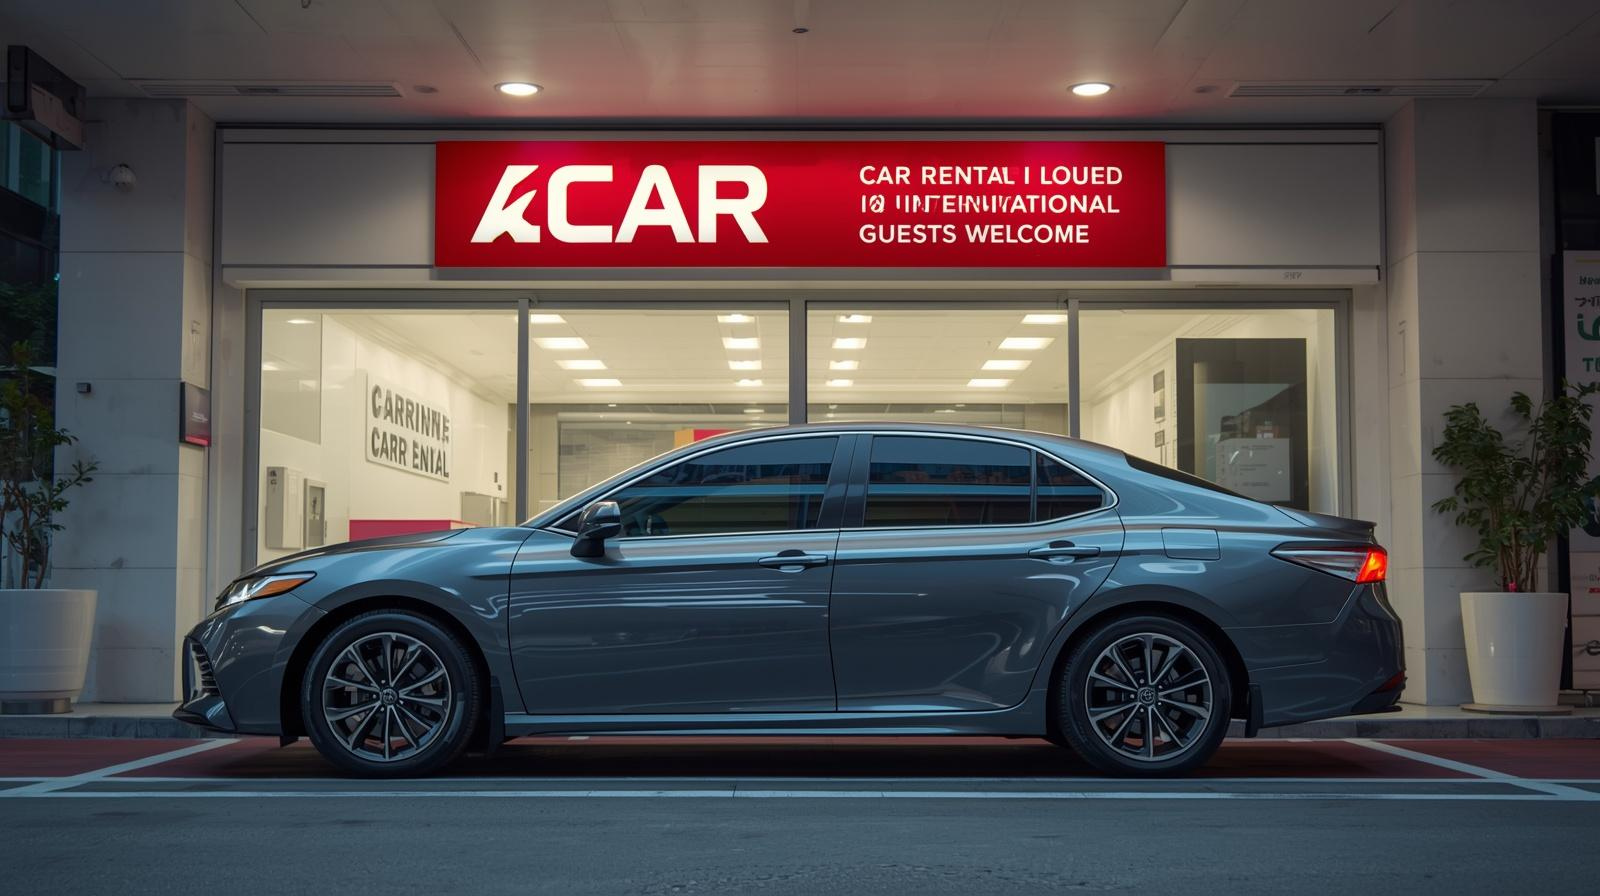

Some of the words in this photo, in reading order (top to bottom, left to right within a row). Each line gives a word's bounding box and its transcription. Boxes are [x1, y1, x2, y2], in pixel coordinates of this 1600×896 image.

[859, 165, 911, 185] CAR
[921, 166, 1016, 185] RENTAL
[1040, 165, 1123, 185] LOUED
[859, 223, 957, 244] GUESTS
[964, 223, 1090, 244] WELCOME
[371, 426, 407, 467] CARR
